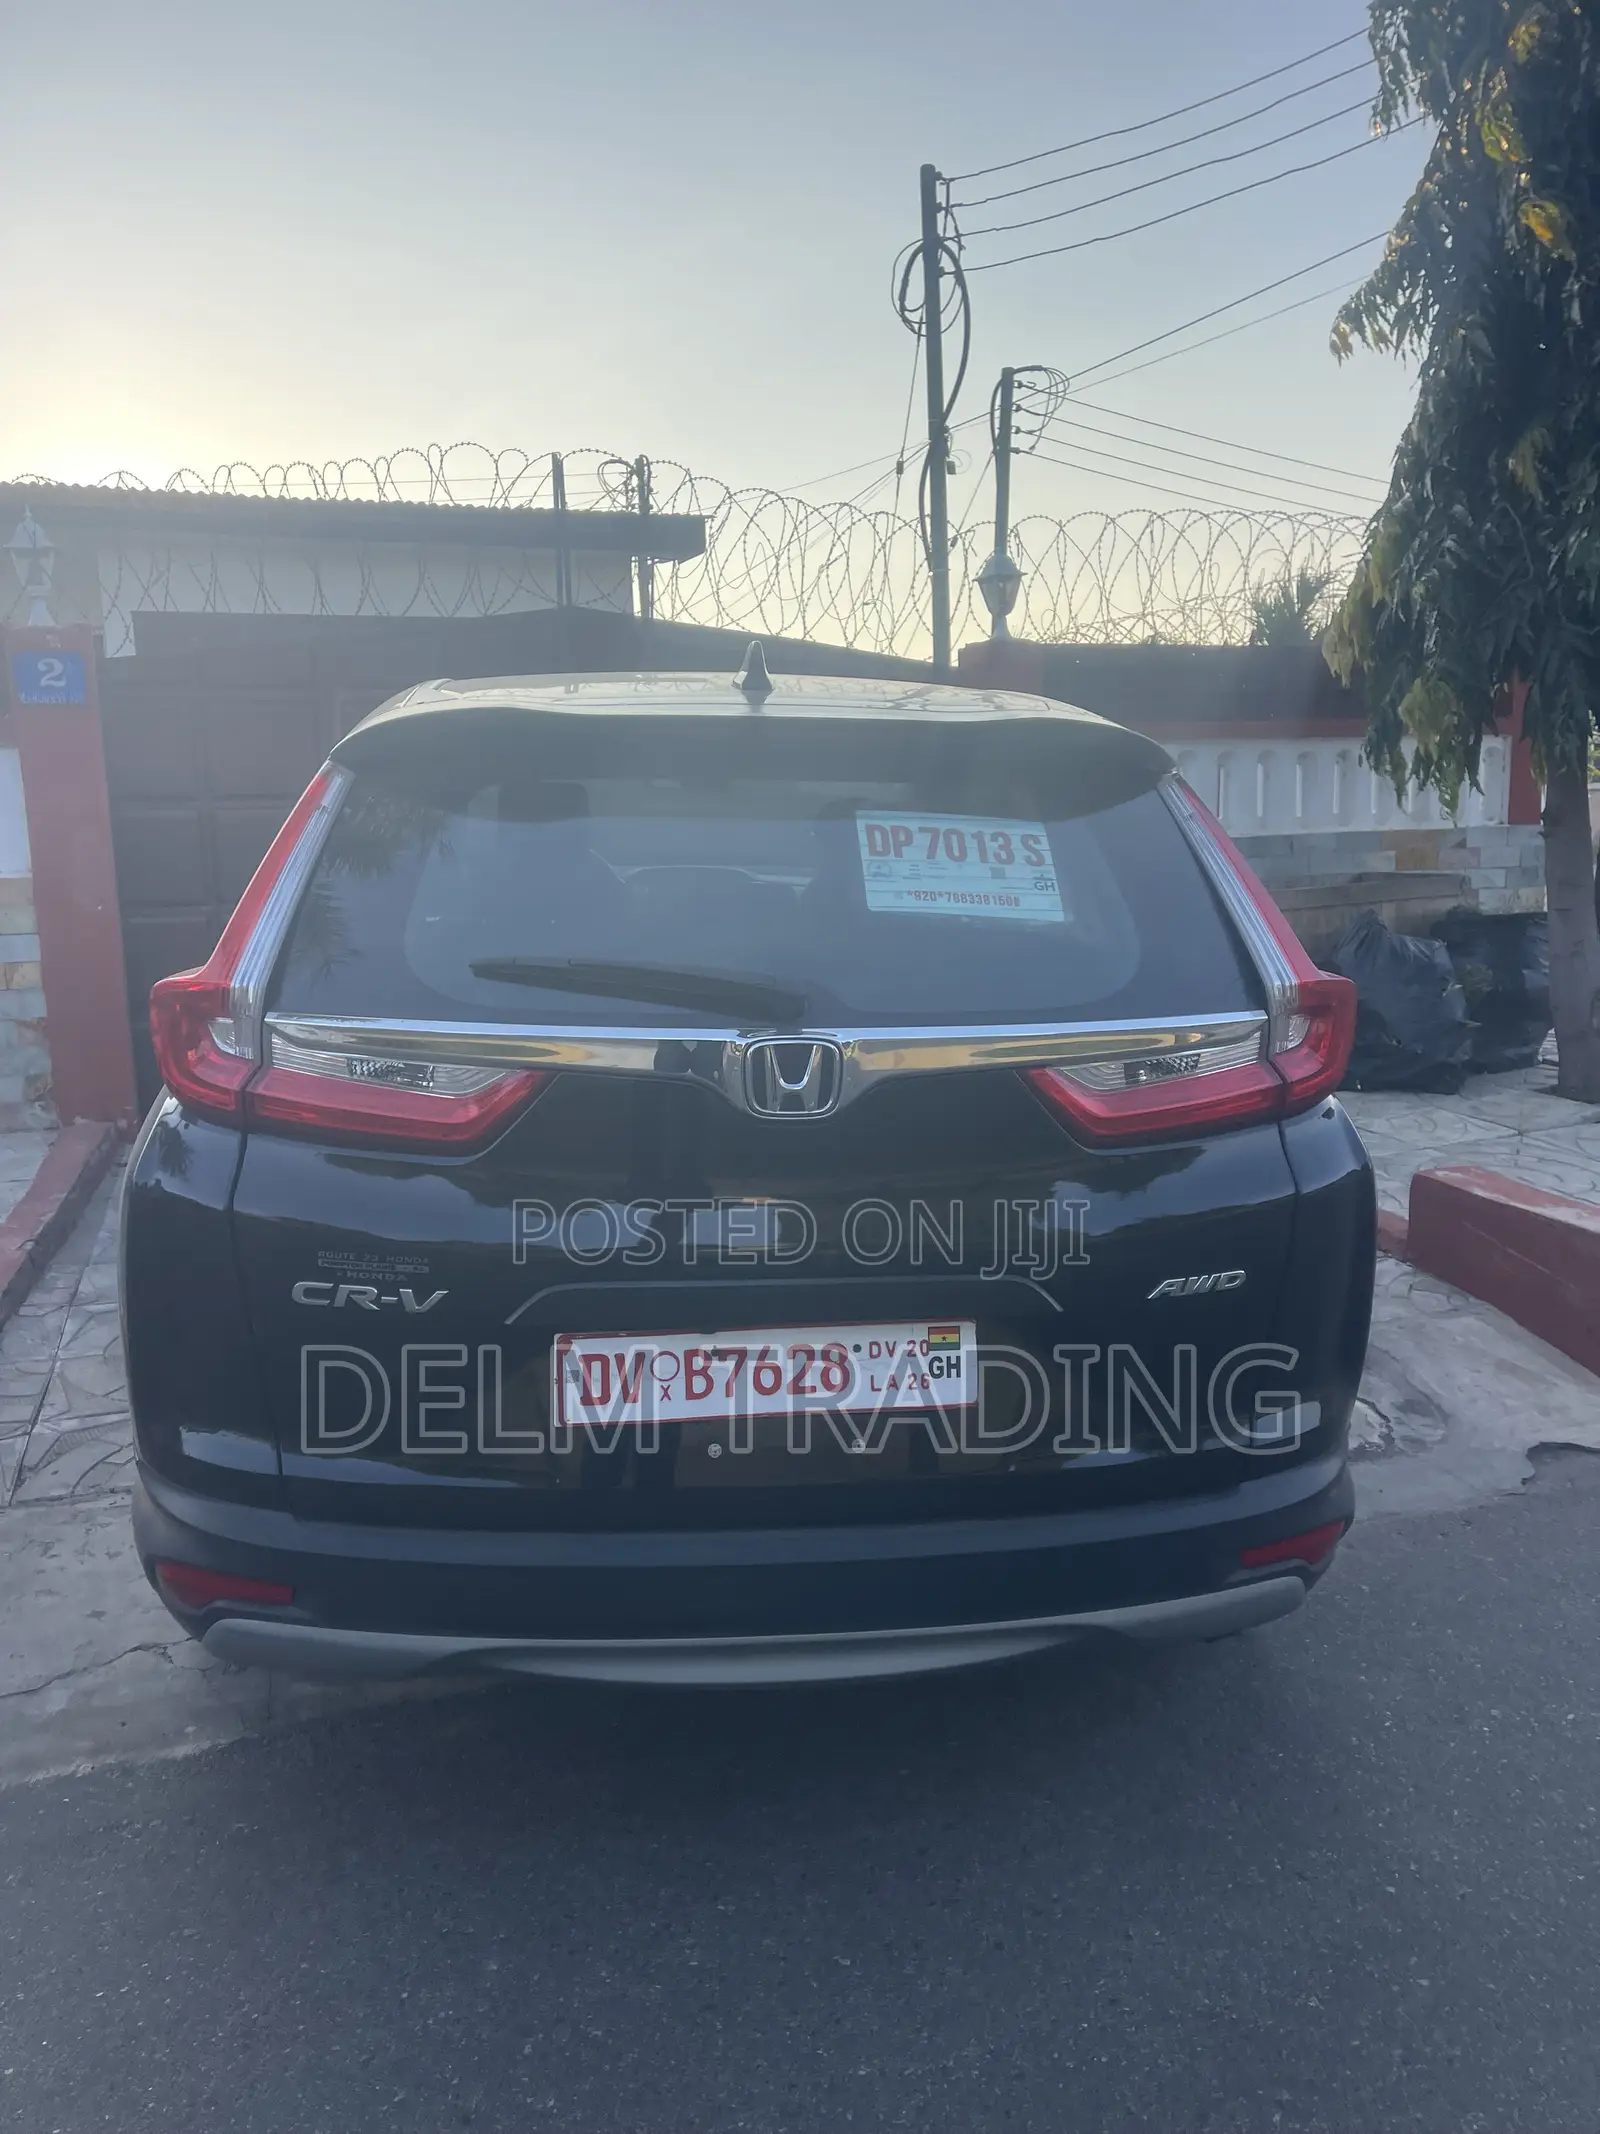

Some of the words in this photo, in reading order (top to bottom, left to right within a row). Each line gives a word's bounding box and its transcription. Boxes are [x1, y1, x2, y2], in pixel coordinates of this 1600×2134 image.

[37, 658, 66, 687] 2
[865, 823, 914, 858] DP
[918, 826, 1015, 866] 7013
[1020, 833, 1046, 867] S
[1034, 881, 1056, 892] GH
[317, 1250, 356, 1260] ROUTE
[386, 1254, 430, 1264] HONDA
[346, 1270, 408, 1282] HONDA
[1147, 1270, 1247, 1300] AWD
[291, 1281, 449, 1314] CR-V
[869, 1340, 897, 1360] DV
[907, 1339, 931, 1358] 20
[579, 1352, 646, 1406] DV
[684, 1342, 850, 1401] B7628
[928, 1355, 961, 1380] GH
[870, 1374, 899, 1392] LA
[908, 1372, 931, 1390] 26
